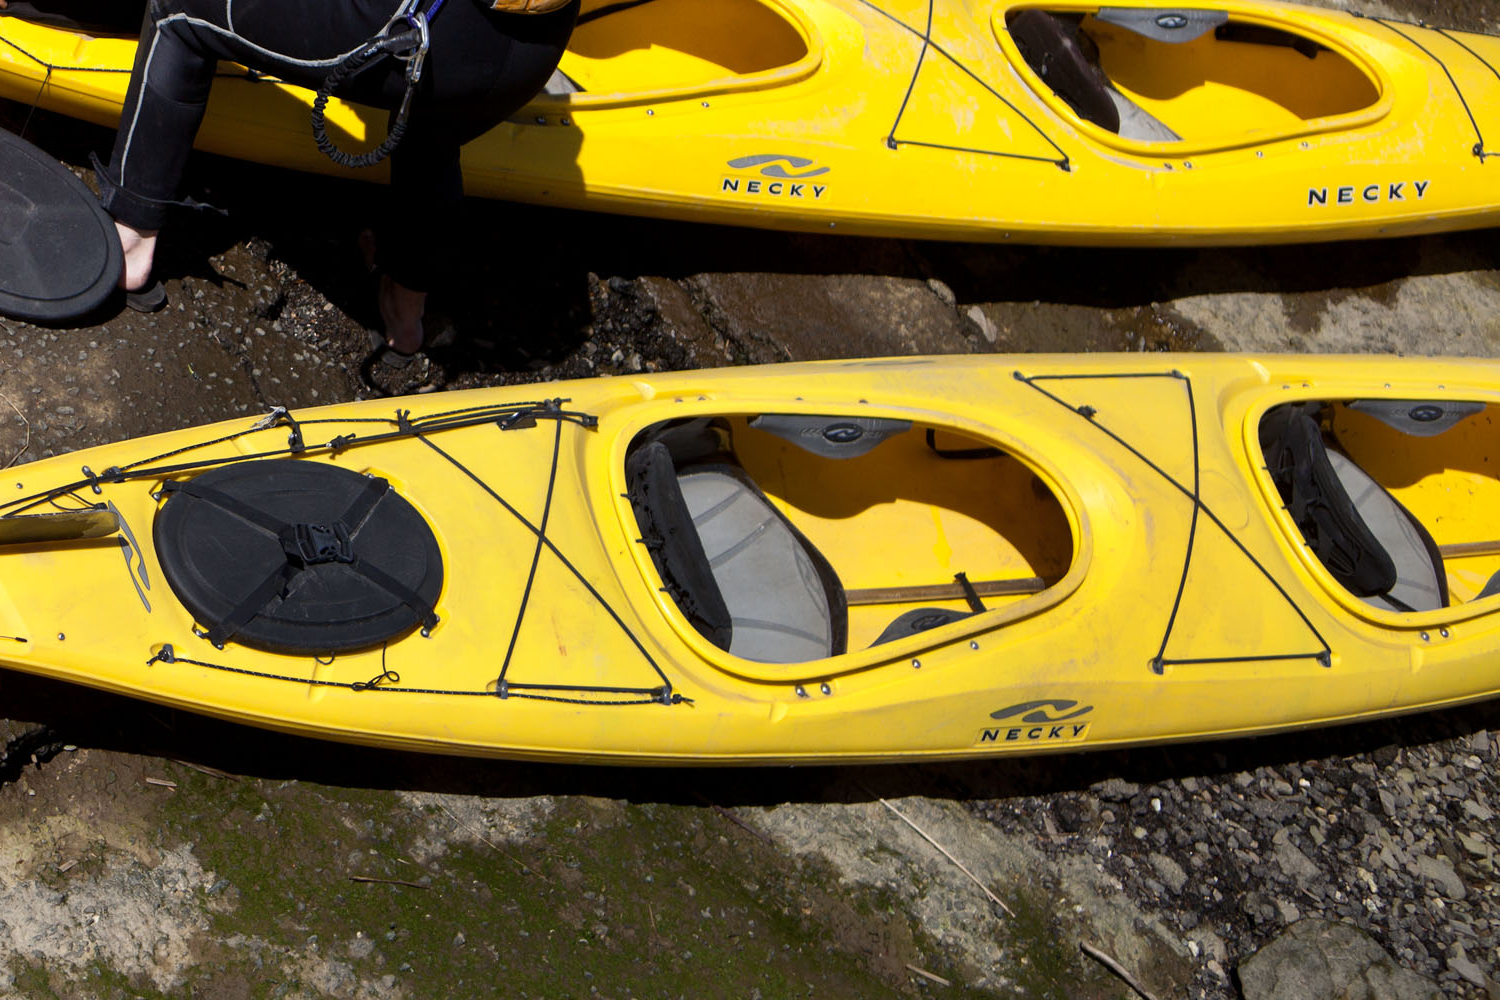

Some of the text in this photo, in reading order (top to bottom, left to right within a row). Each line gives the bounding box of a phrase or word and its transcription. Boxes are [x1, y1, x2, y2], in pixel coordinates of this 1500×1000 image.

[722, 178, 825, 198] NECKY
[1307, 180, 1429, 206] NECKY
[980, 724, 1086, 742] NECKY
